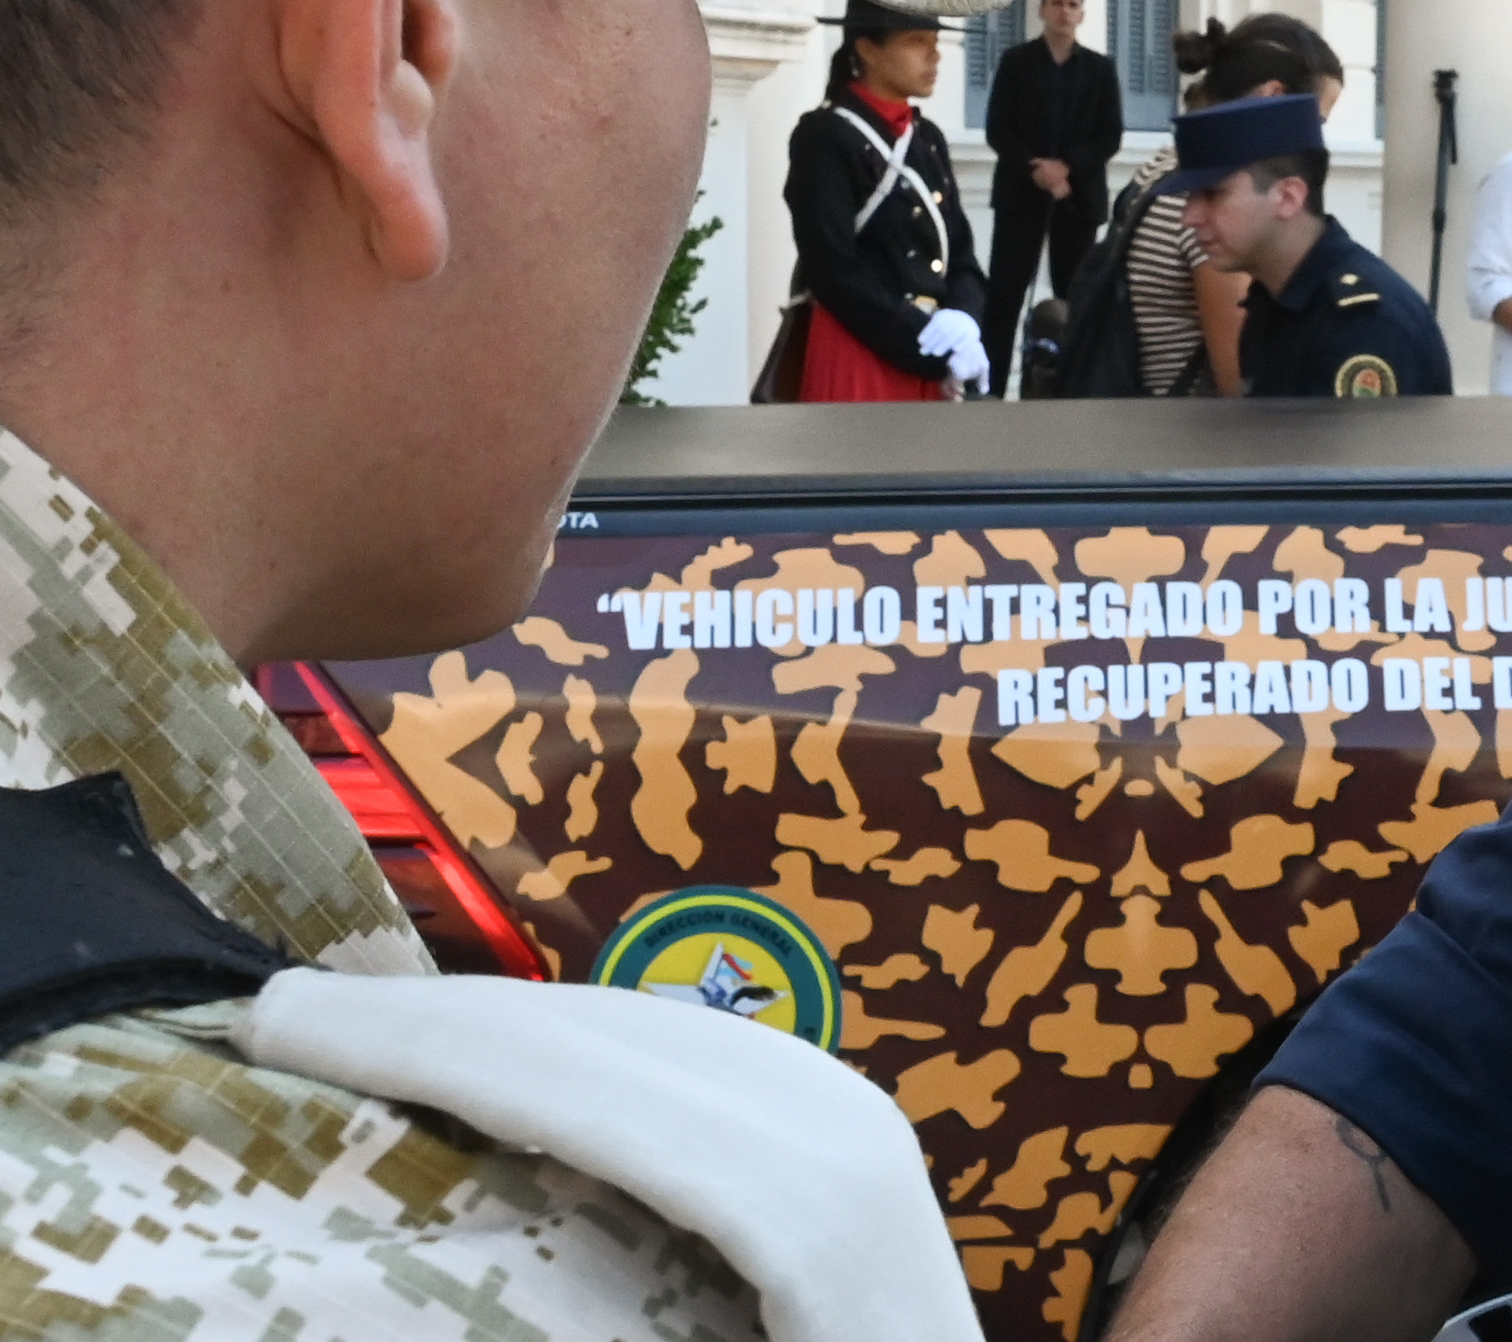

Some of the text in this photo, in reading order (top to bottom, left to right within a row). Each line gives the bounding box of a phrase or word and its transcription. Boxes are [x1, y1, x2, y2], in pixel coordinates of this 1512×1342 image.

[916, 578, 1244, 644] ENTREGADO
[1257, 577, 1371, 635] POR
[1384, 577, 1452, 633] LA
[997, 658, 1369, 726] RECUPERADO
[1383, 656, 1482, 711] DEL
